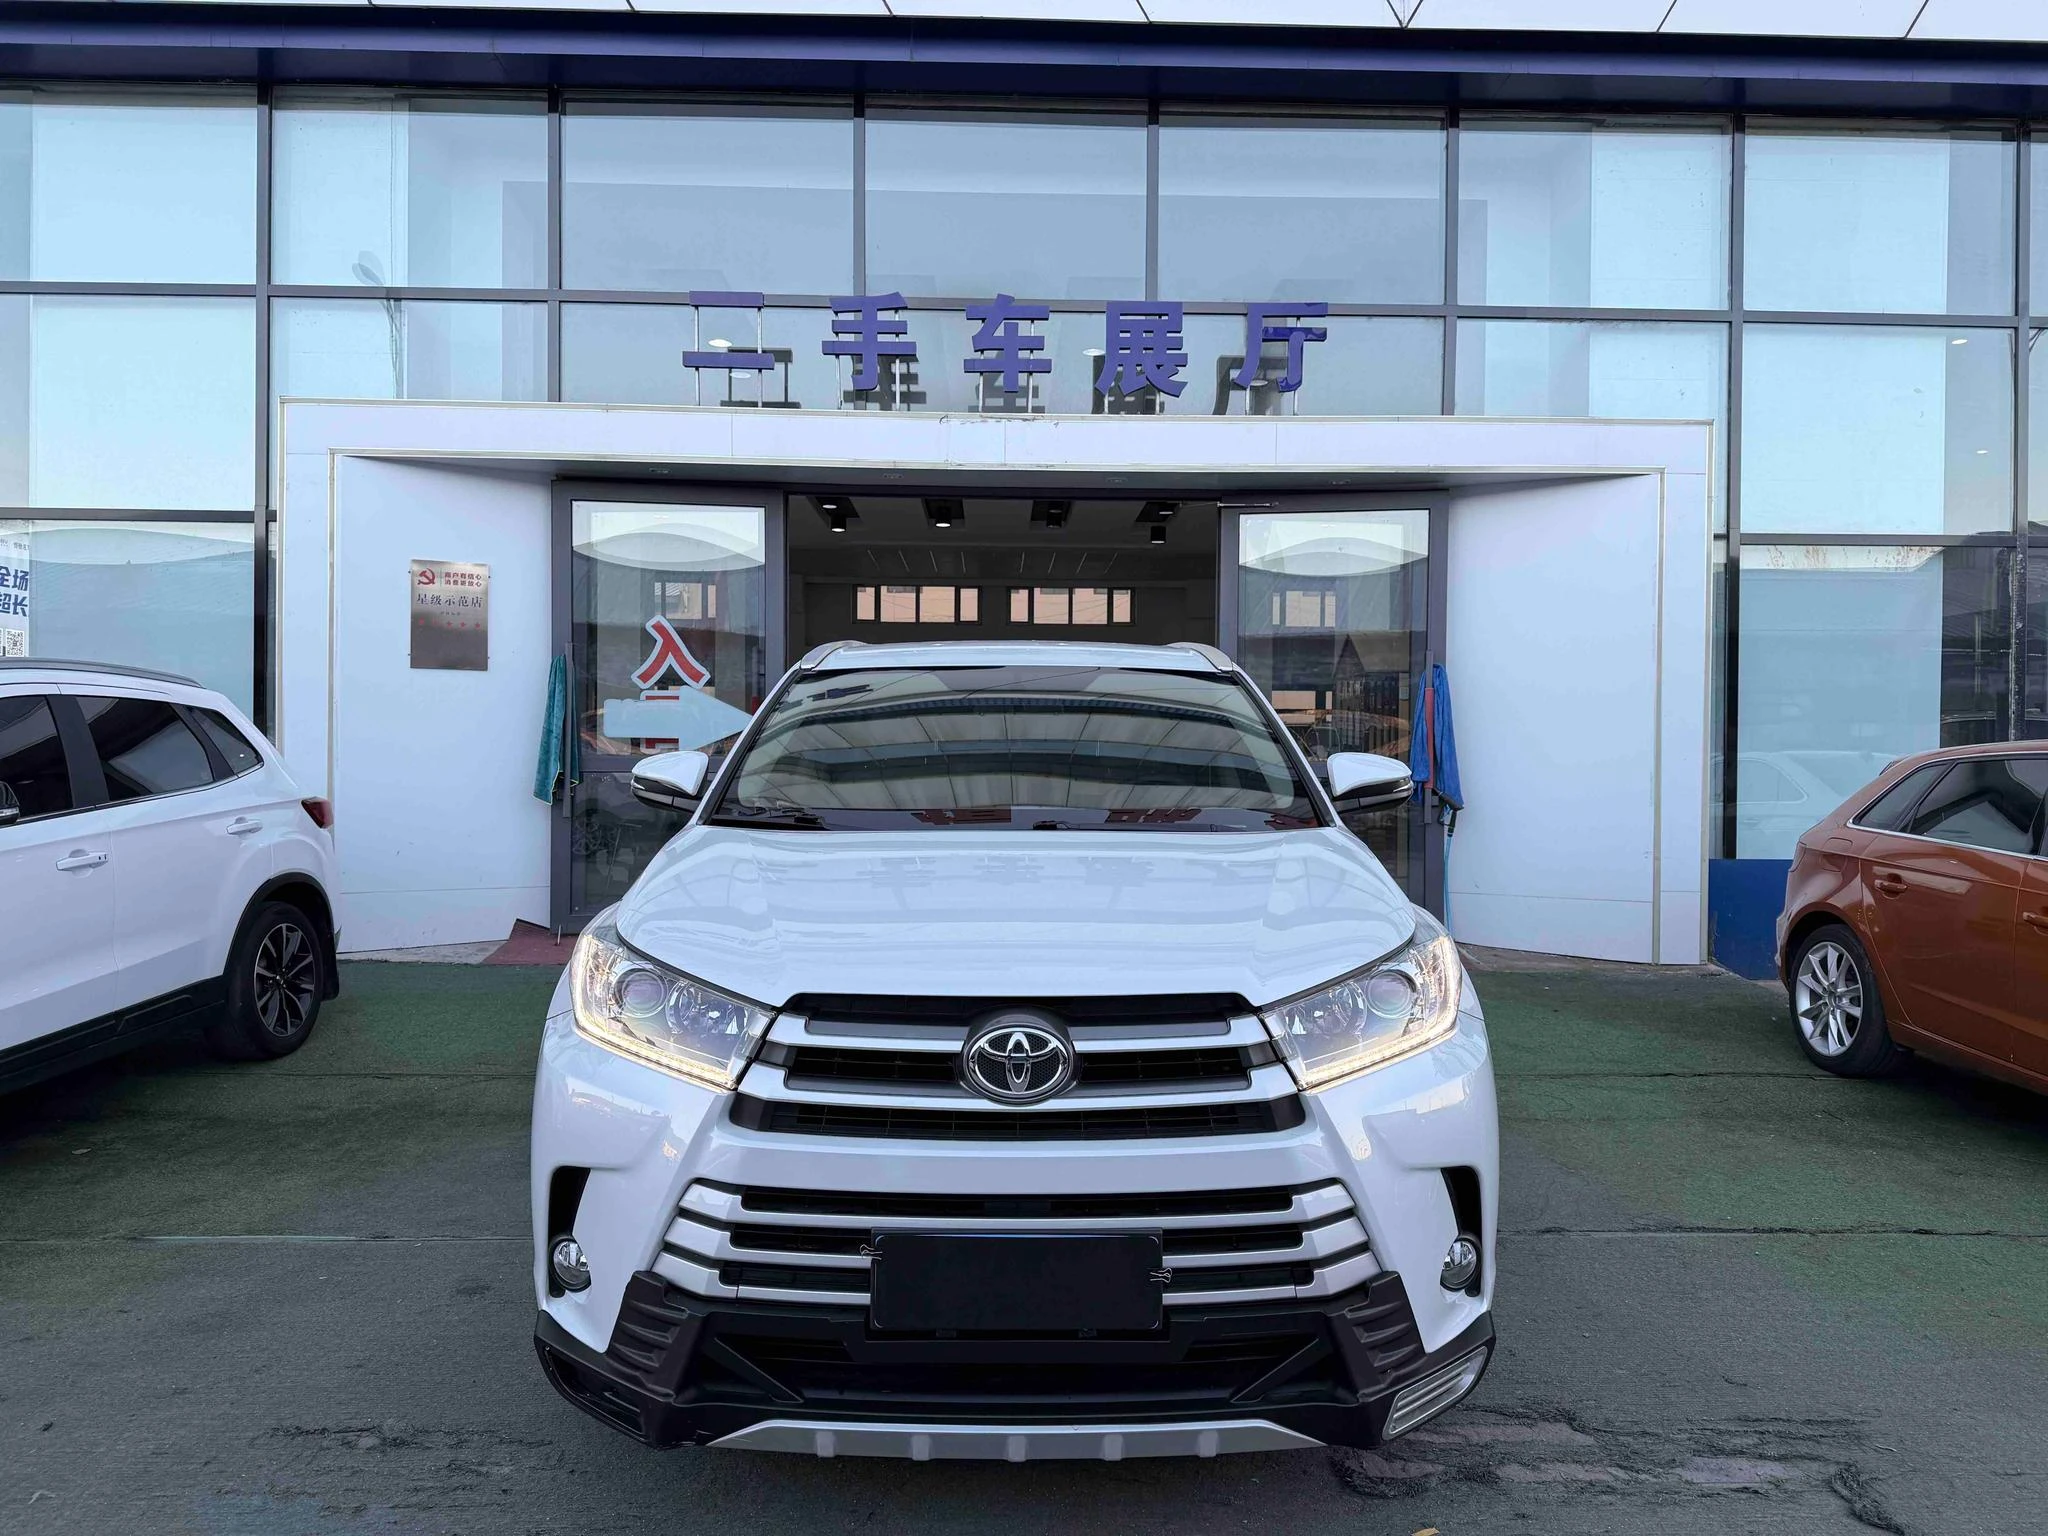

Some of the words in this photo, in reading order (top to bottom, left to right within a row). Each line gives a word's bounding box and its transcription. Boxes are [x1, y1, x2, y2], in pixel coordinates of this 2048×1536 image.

[682, 291, 1328, 397] 二手车展厅
[416, 593, 483, 608] 星级示范店
